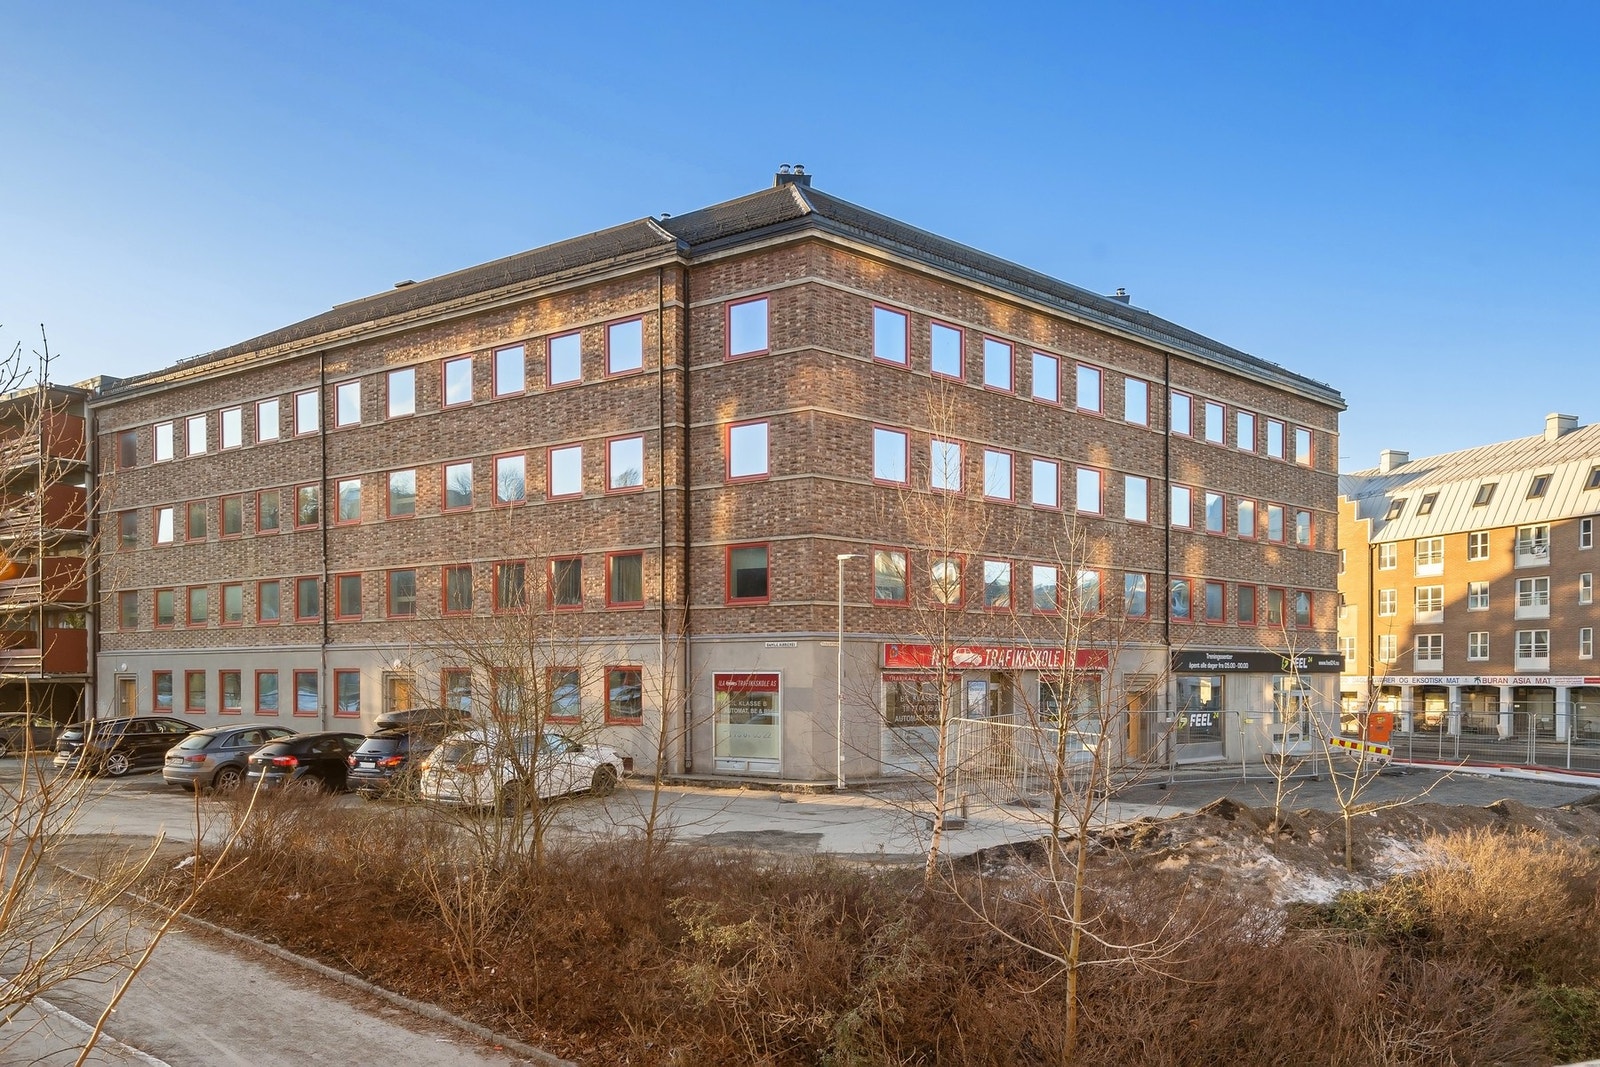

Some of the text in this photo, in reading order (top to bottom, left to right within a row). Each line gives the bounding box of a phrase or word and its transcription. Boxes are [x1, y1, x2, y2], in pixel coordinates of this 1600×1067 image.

[985, 648, 1061, 668] TRAFIKKSKOLE
[1482, 676, 1509, 685] BURAN
[1512, 677, 1532, 685] ASIA
[1535, 677, 1552, 685] MAT
[1189, 713, 1213, 727] FEEL
